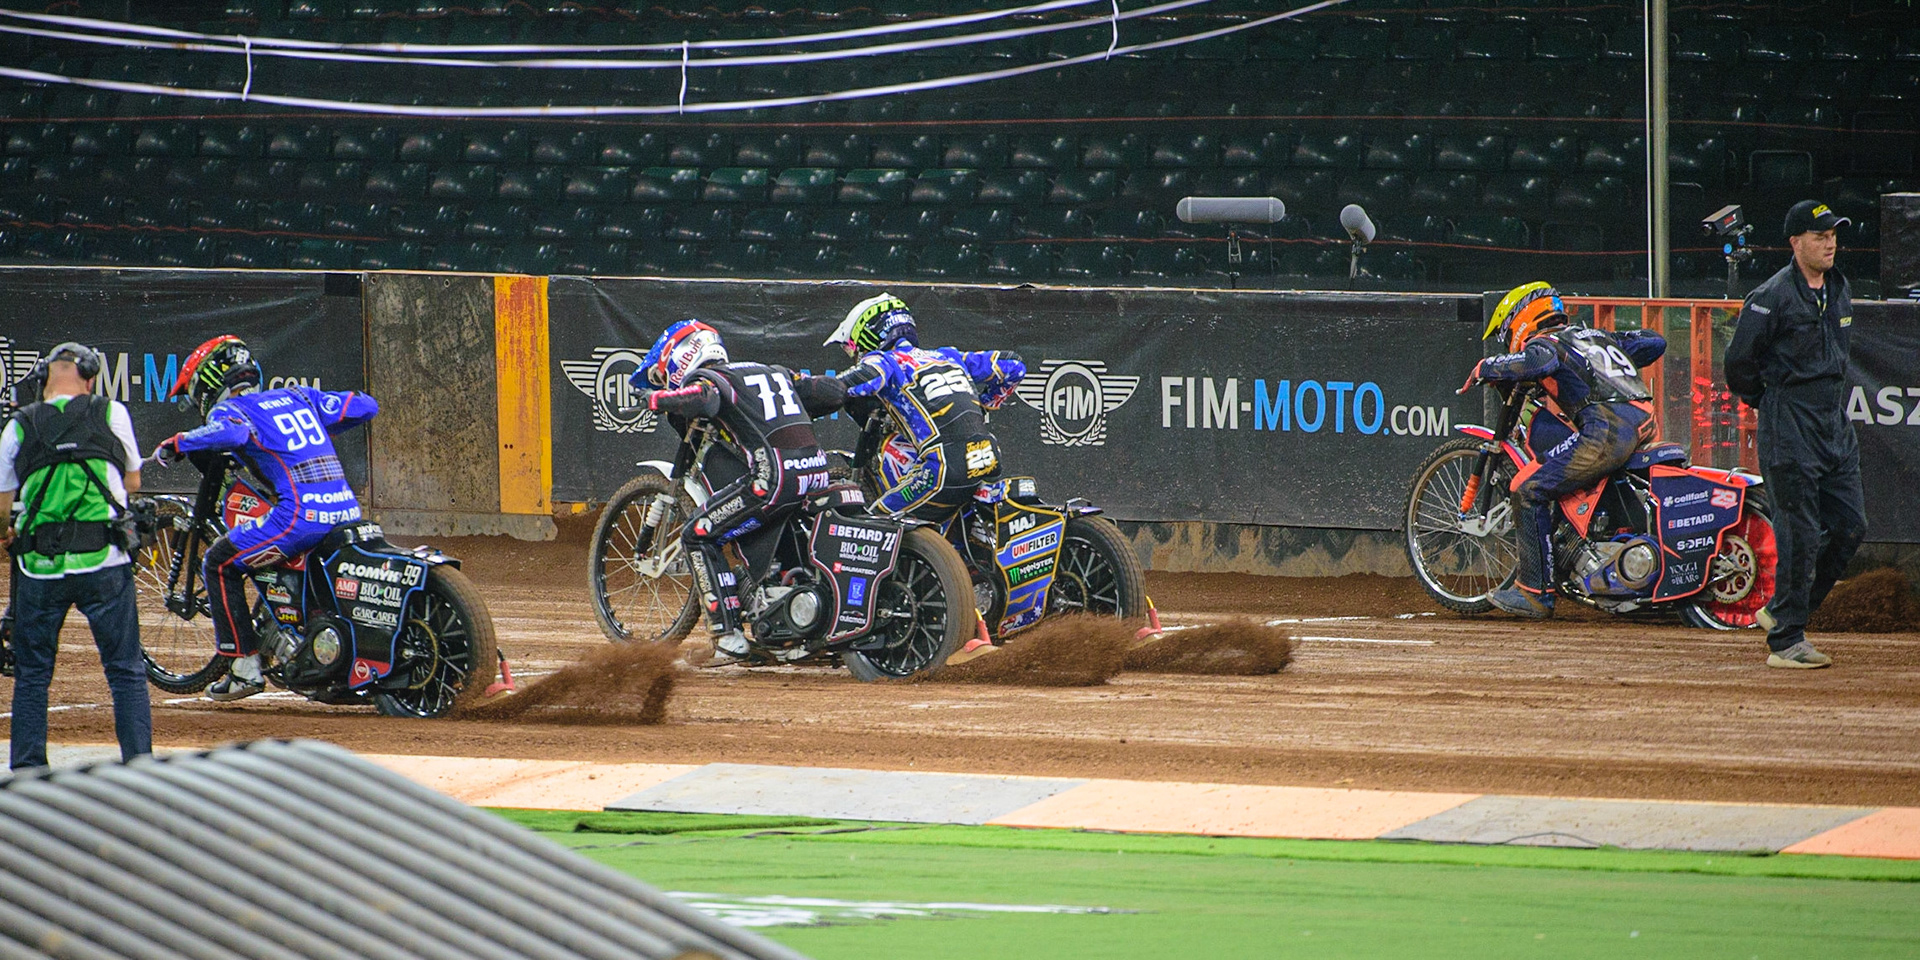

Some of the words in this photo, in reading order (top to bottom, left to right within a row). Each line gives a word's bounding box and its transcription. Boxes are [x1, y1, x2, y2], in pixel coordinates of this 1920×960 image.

[1588, 344, 1638, 378] 29
[670, 360, 688, 385] Red
[920, 368, 974, 401] 25
[743, 373, 802, 422] 71
[1053, 385, 1094, 421] FIM
[1161, 376, 1449, 437] FIM-MOTO.COM
[273, 408, 326, 452] 99
[966, 444, 994, 470] 25
[1711, 488, 1738, 509] 29
[1009, 513, 1036, 535] HAJ
[1677, 513, 1715, 528] BETARD
[837, 525, 883, 542] BETARD
[881, 533, 897, 552] 71
[840, 542, 858, 554] BIO
[862, 544, 879, 558] OIL
[1013, 533, 1056, 557] UNIFILTER
[401, 565, 422, 587] 99
[1020, 557, 1054, 575] MONSTER
[336, 580, 358, 592] AMD
[360, 582, 379, 597] BIO
[383, 585, 402, 600] OIL
[352, 606, 399, 624] GARCAREK
